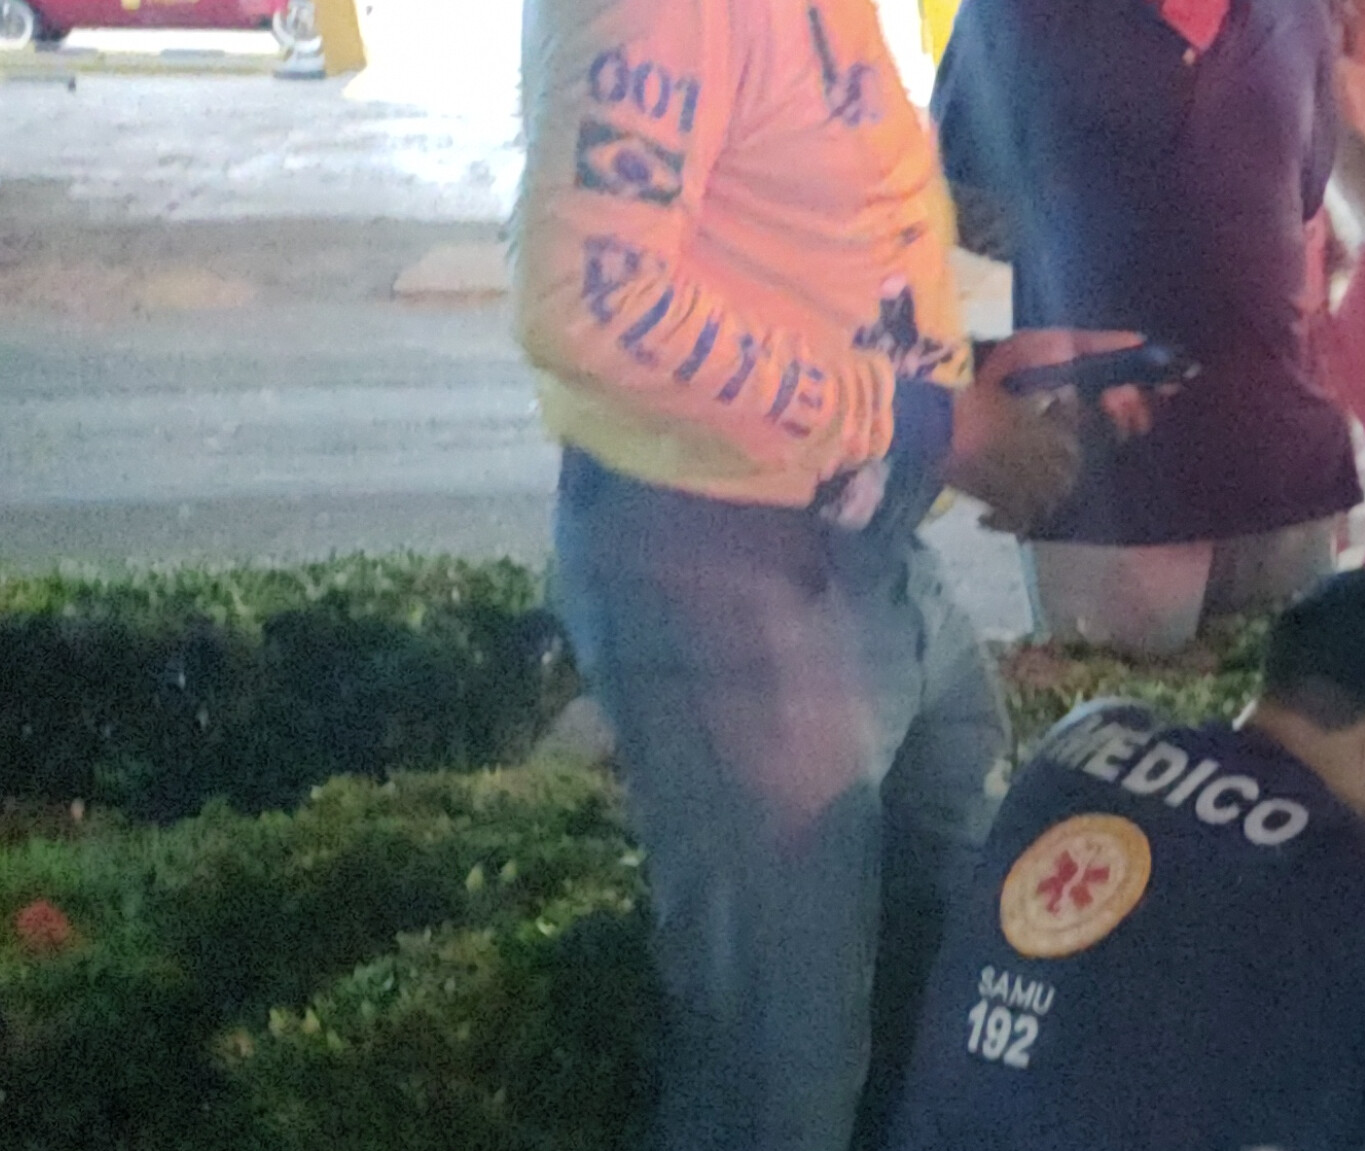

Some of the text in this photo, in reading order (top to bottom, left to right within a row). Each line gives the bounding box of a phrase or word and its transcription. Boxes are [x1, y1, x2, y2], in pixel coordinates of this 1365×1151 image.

[589, 47, 700, 134] 001
[978, 965, 1055, 1016] SAMU
[967, 998, 1039, 1070] 192
